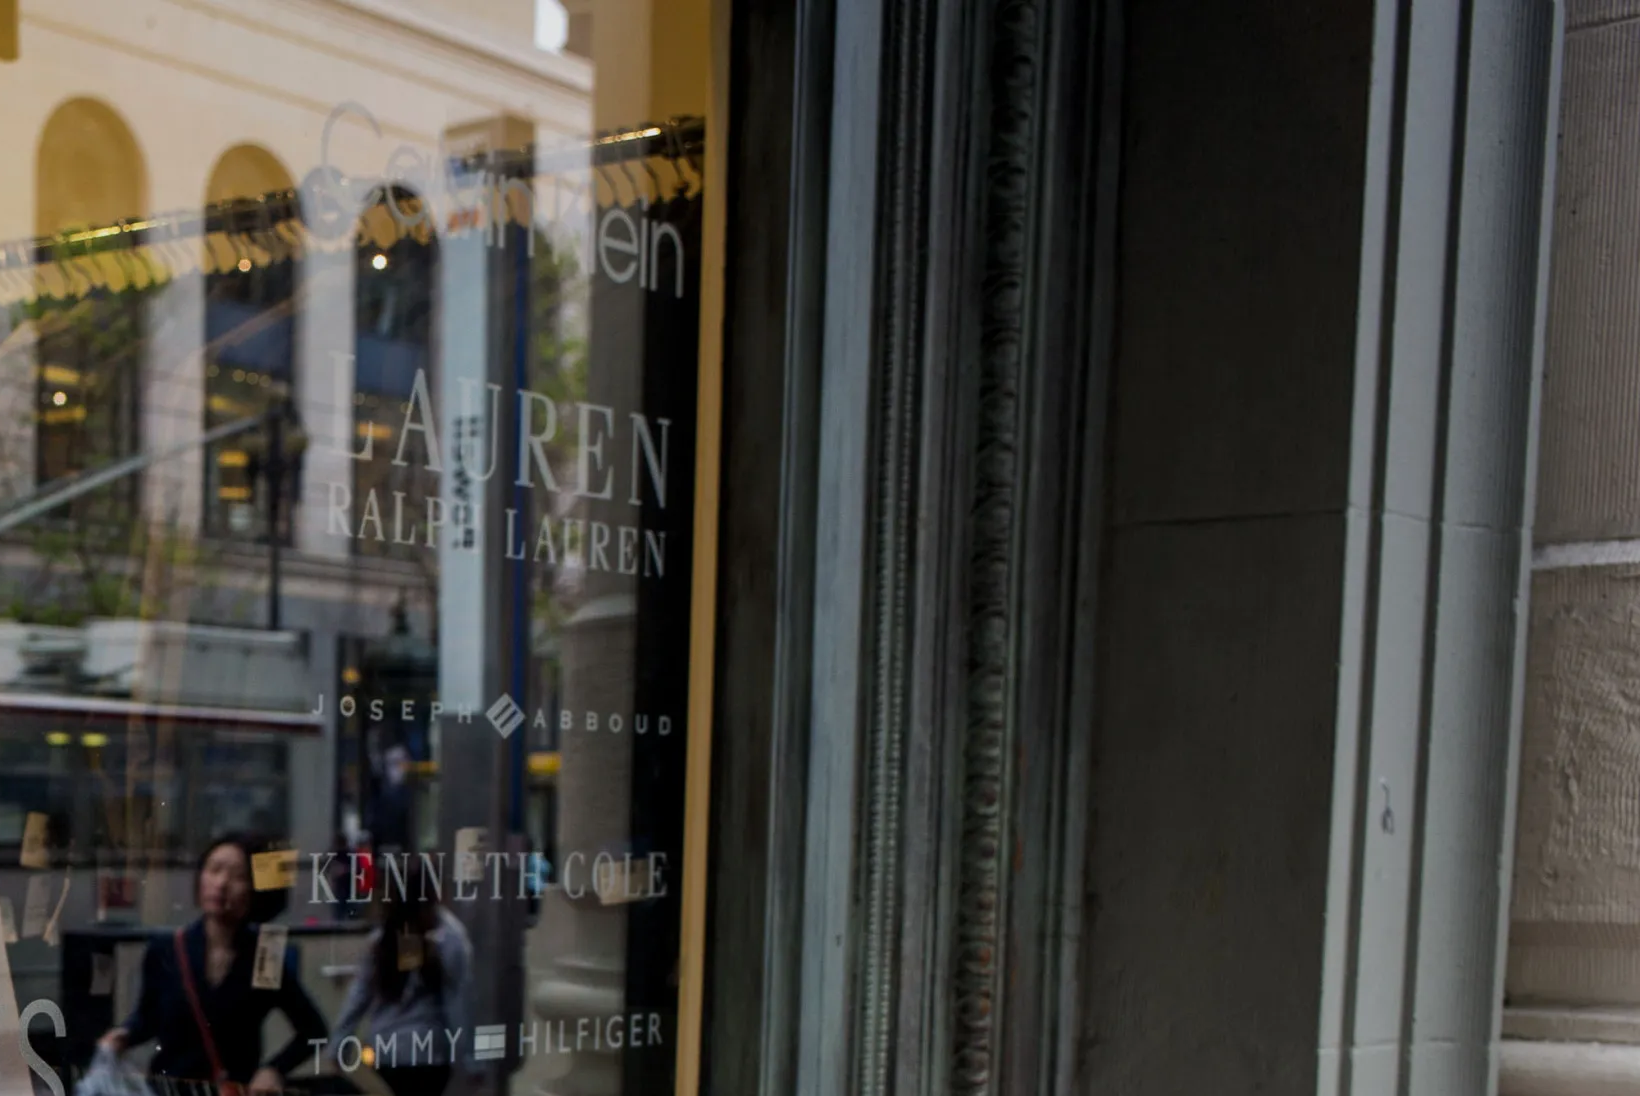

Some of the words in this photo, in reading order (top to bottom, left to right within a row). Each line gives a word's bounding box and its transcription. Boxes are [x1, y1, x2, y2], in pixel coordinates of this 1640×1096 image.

[328, 353, 672, 509] LAUREN
[504, 508, 667, 578] LAUREN
[312, 693, 473, 727] JOSEPH
[532, 710, 672, 736] ABBOUD
[308, 851, 545, 904] KENNETH
[563, 850, 668, 899] COLE
[307, 1027, 463, 1075] TOMMY
[519, 1012, 663, 1058] HILFIGER
